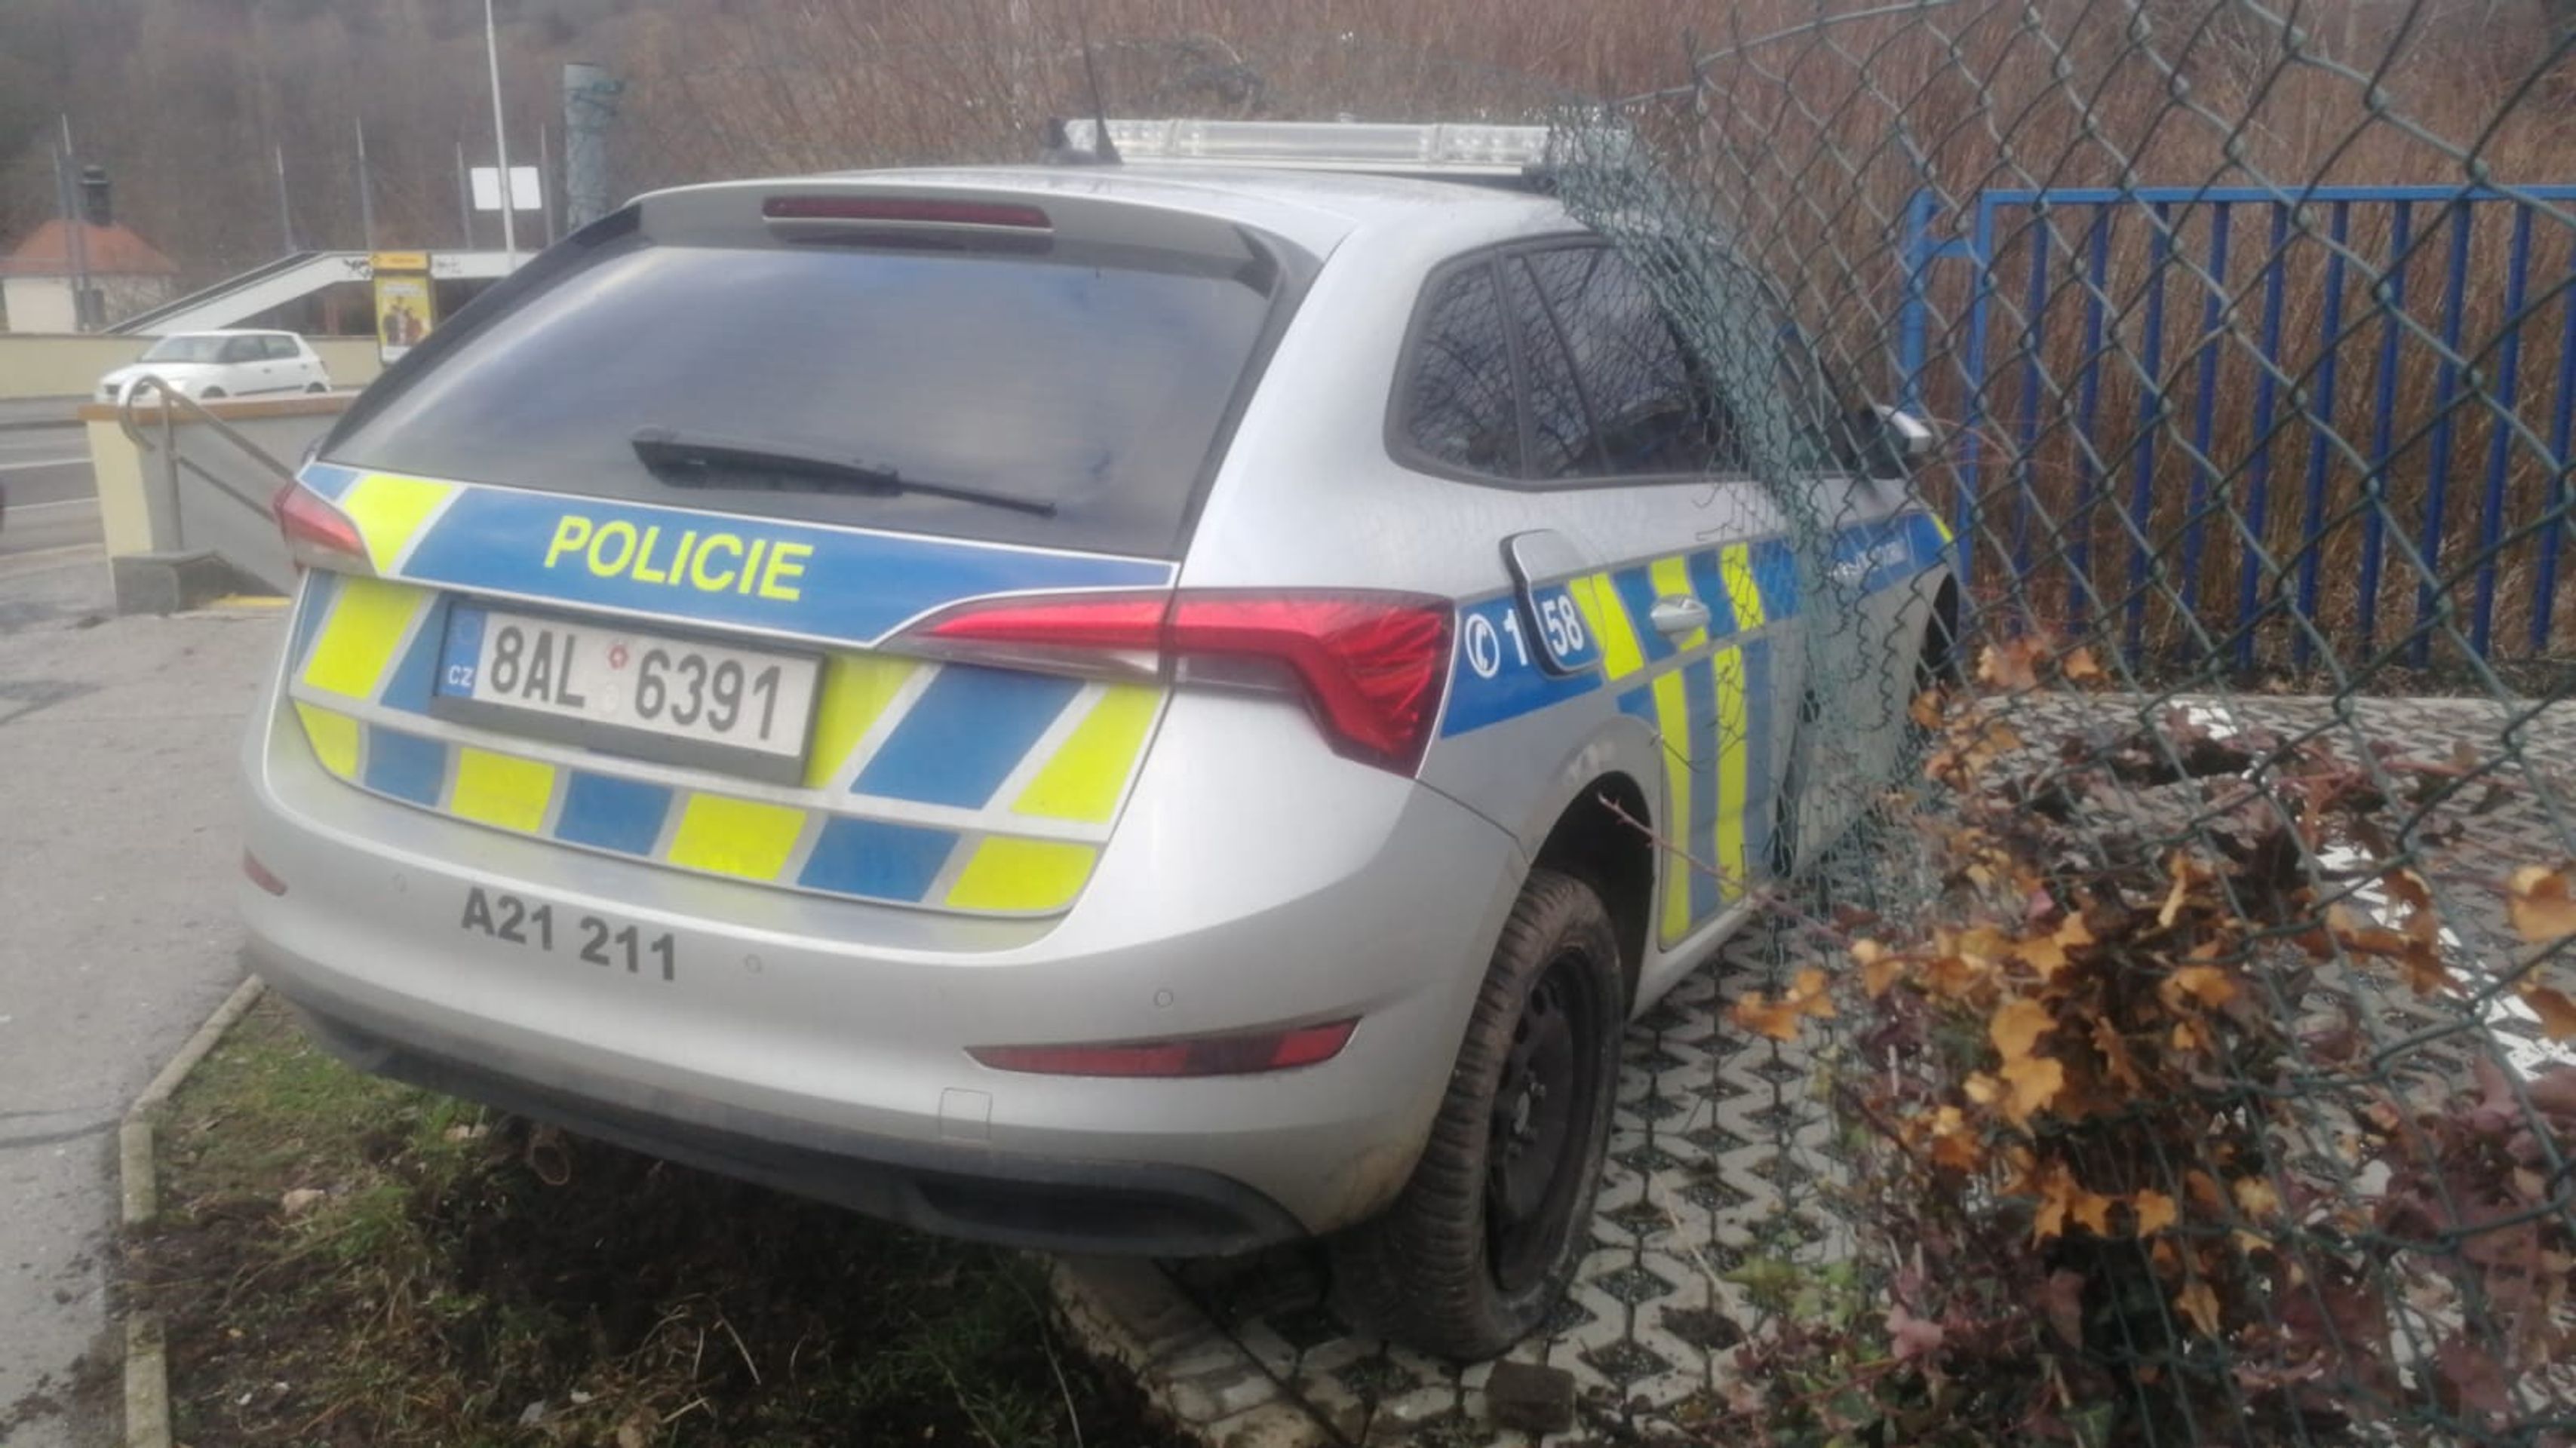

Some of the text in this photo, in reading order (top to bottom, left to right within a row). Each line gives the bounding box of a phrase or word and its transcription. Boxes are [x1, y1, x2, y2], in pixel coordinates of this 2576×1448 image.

[543, 515, 813, 602] POLICIE
[448, 664, 475, 687] CZ
[490, 625, 781, 740] 8AL 6391
[462, 886, 675, 983] A21 211
